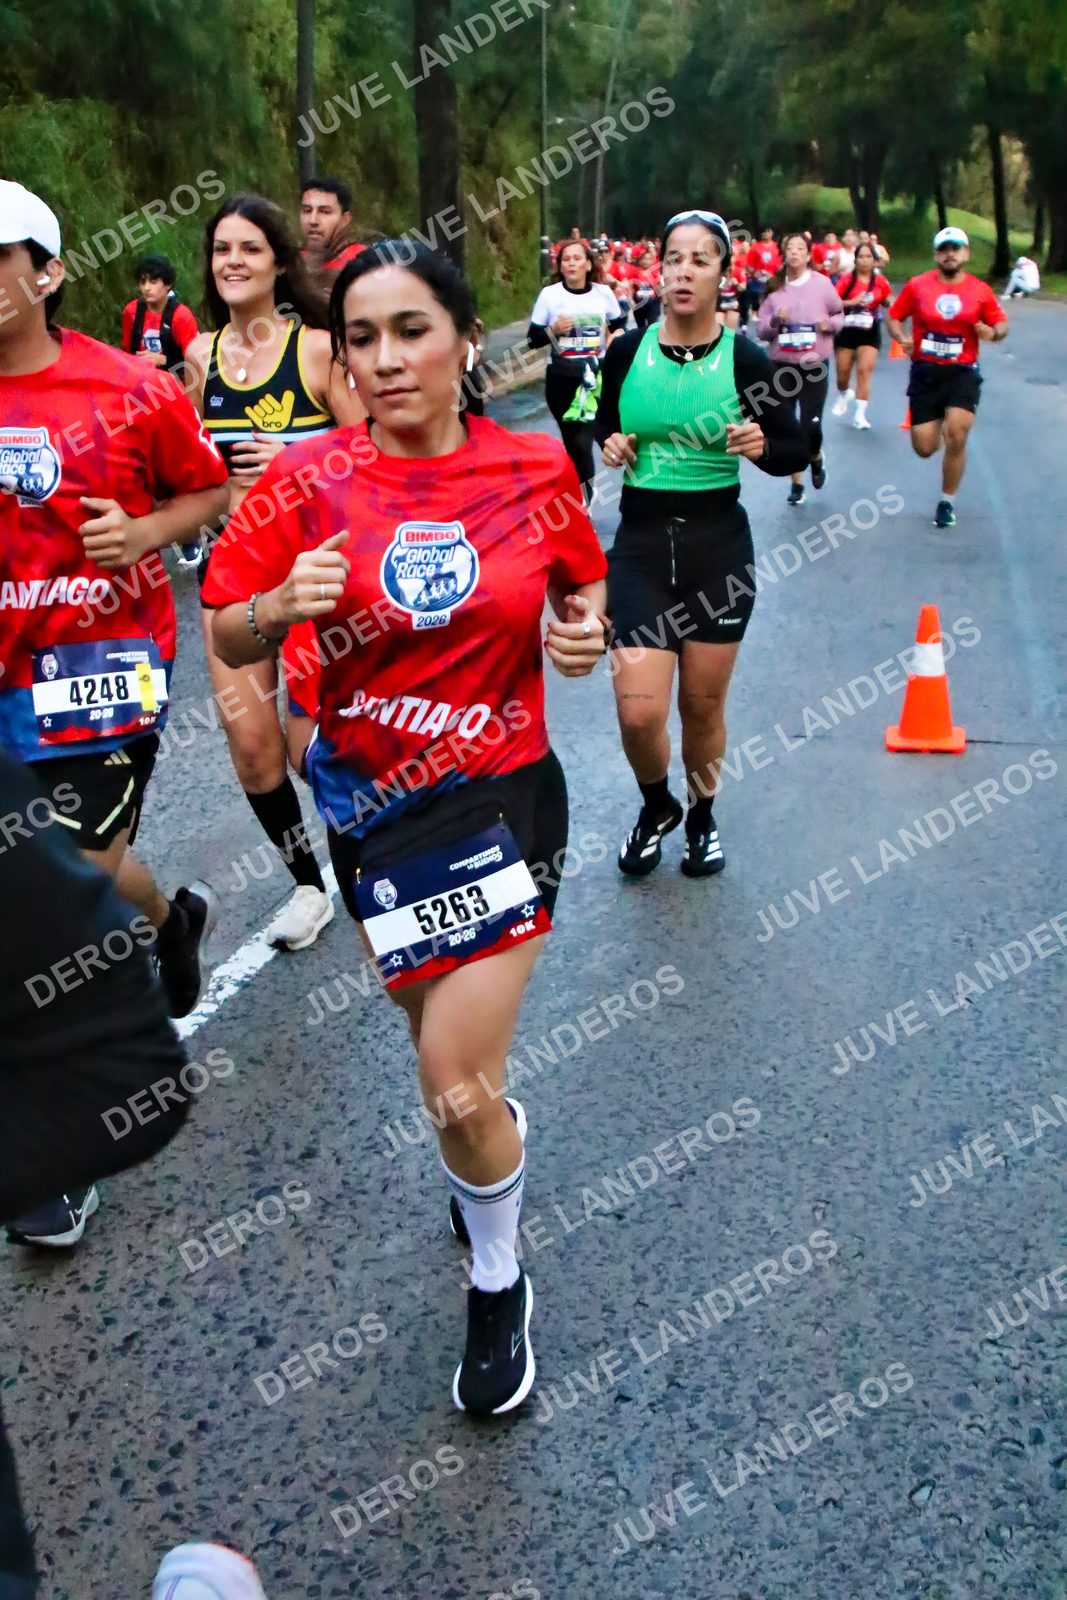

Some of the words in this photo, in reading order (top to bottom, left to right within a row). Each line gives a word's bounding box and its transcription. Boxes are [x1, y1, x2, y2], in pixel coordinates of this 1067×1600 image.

[262, 420, 282, 428] bro
[0, 435, 41, 444] BIMBO
[1, 449, 40, 463] Global
[0, 463, 26, 475] ace
[405, 531, 455, 542] BIMBO
[406, 546, 455, 564] Global
[395, 563, 436, 579] Race
[416, 615, 447, 628] 2026
[70, 675, 129, 706] 4248
[338, 689, 491, 739] SNTIAO
[449, 844, 500, 870] COMPARTIMOS
[412, 885, 490, 935] 5263
[509, 920, 536, 938] 10K
